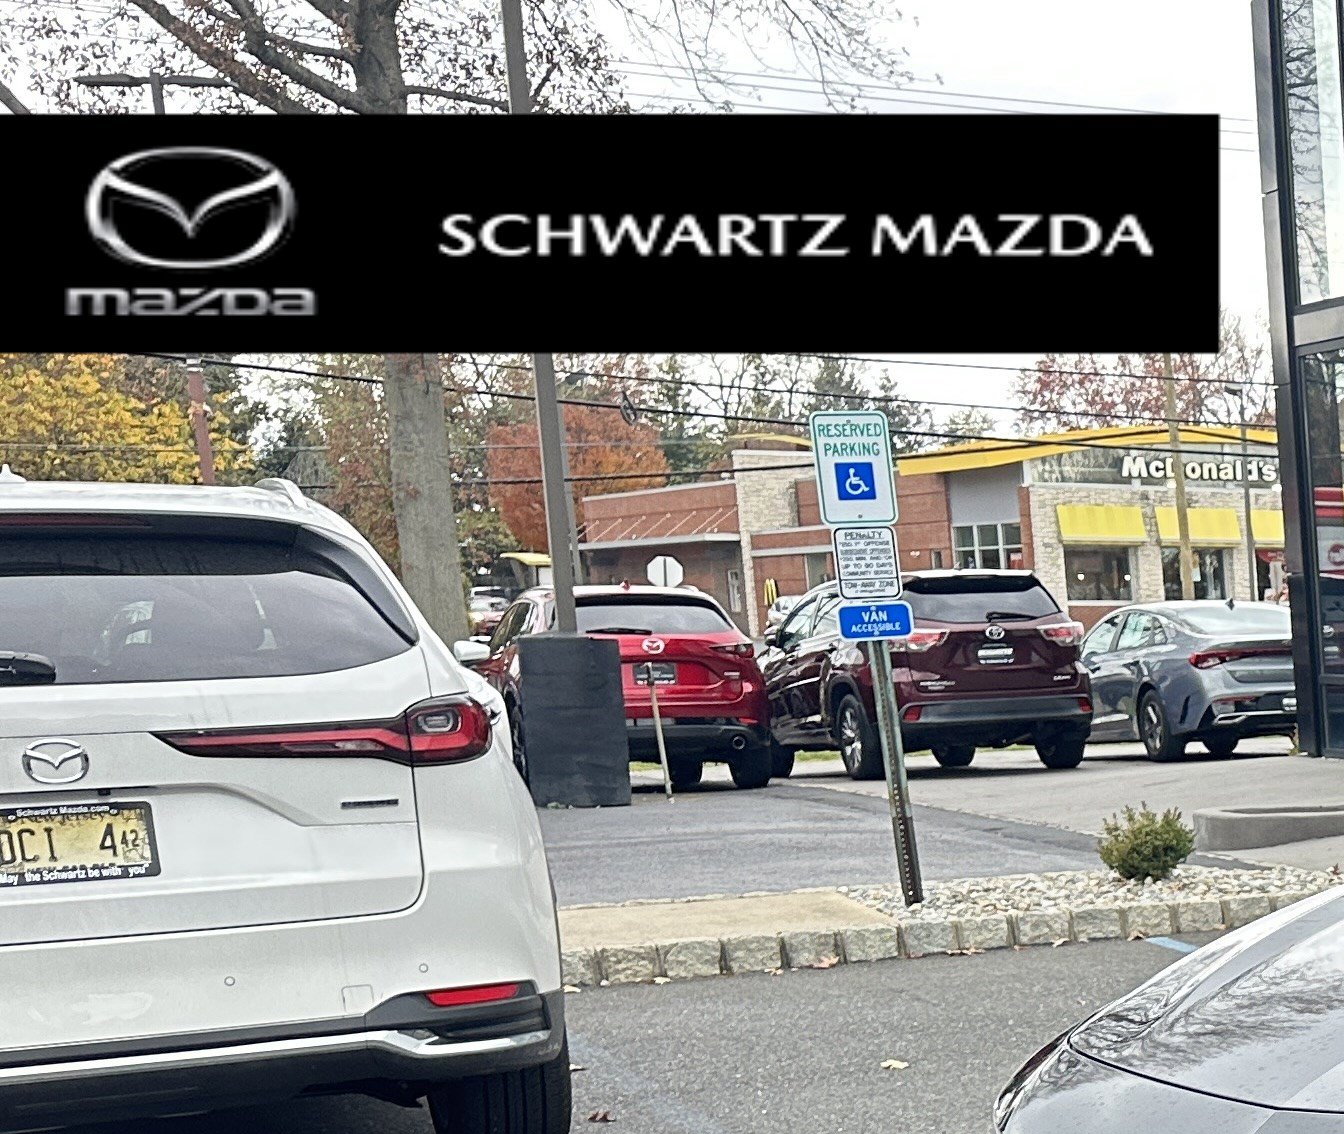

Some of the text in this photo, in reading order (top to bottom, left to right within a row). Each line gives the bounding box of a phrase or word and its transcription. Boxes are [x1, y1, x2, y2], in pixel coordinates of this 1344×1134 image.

[818, 423, 882, 438] RESERVED
[824, 442, 880, 457] PARKING
[861, 610, 887, 622] VAN
[851, 622, 901, 632] ACCESSIBLE
[100, 822, 118, 857] 4
[25, 871, 41, 882] the
[88, 866, 100, 877] be
